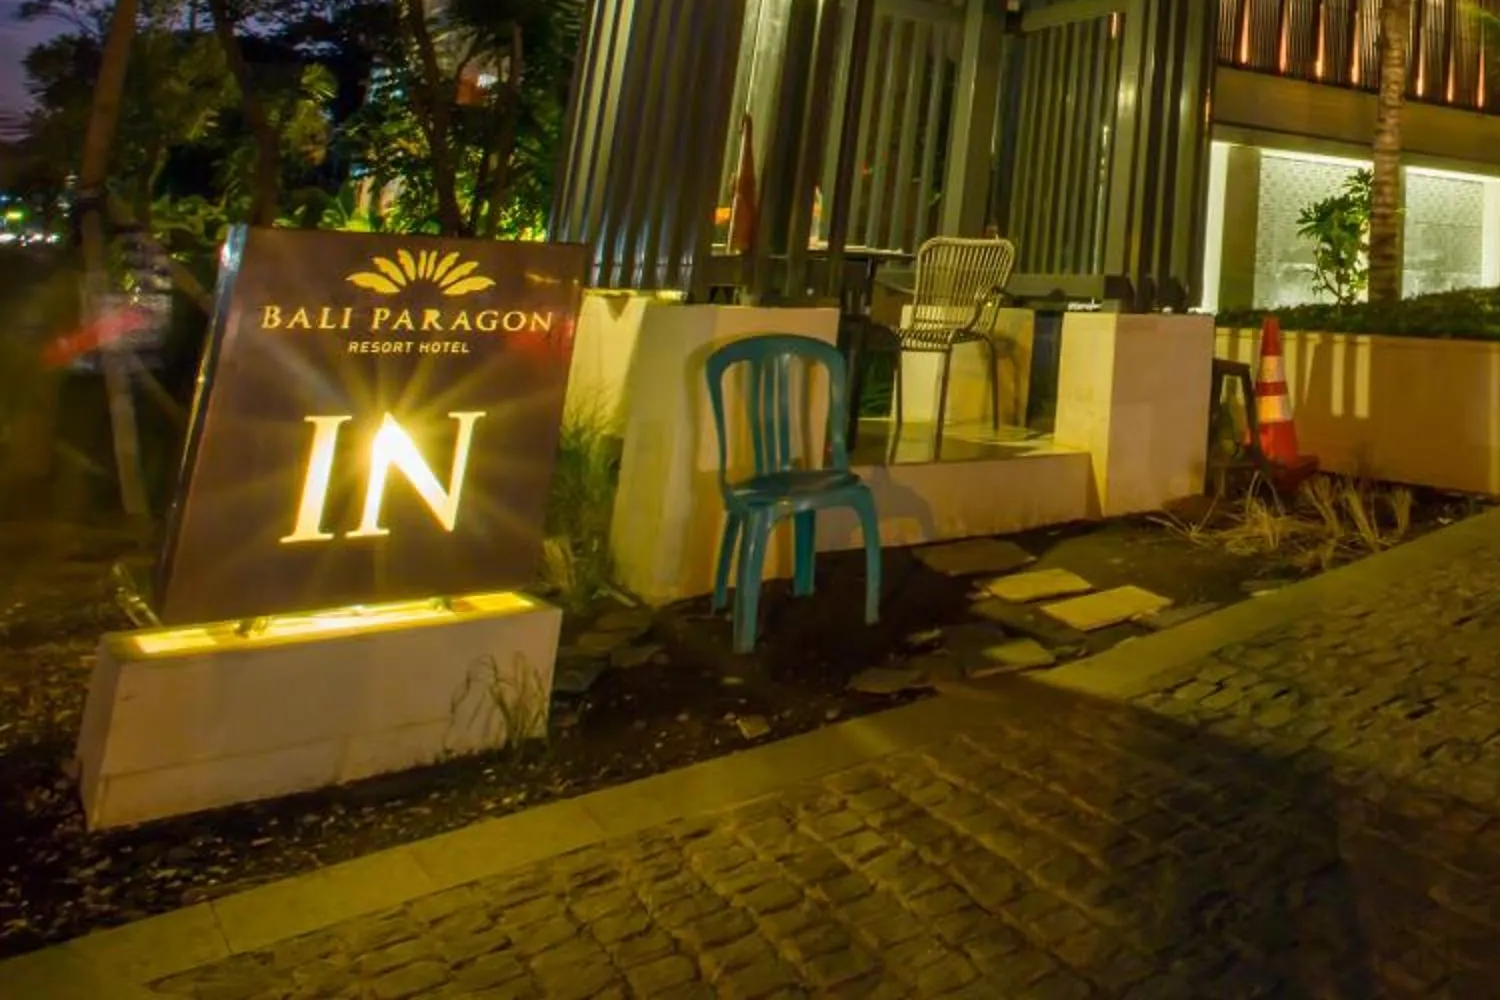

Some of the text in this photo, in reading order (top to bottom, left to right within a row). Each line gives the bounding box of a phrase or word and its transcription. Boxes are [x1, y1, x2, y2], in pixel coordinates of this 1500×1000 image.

[261, 305, 553, 332] BALI PARAGON
[348, 341, 470, 353] RESORT HOTEL
[279, 411, 486, 543] IN
